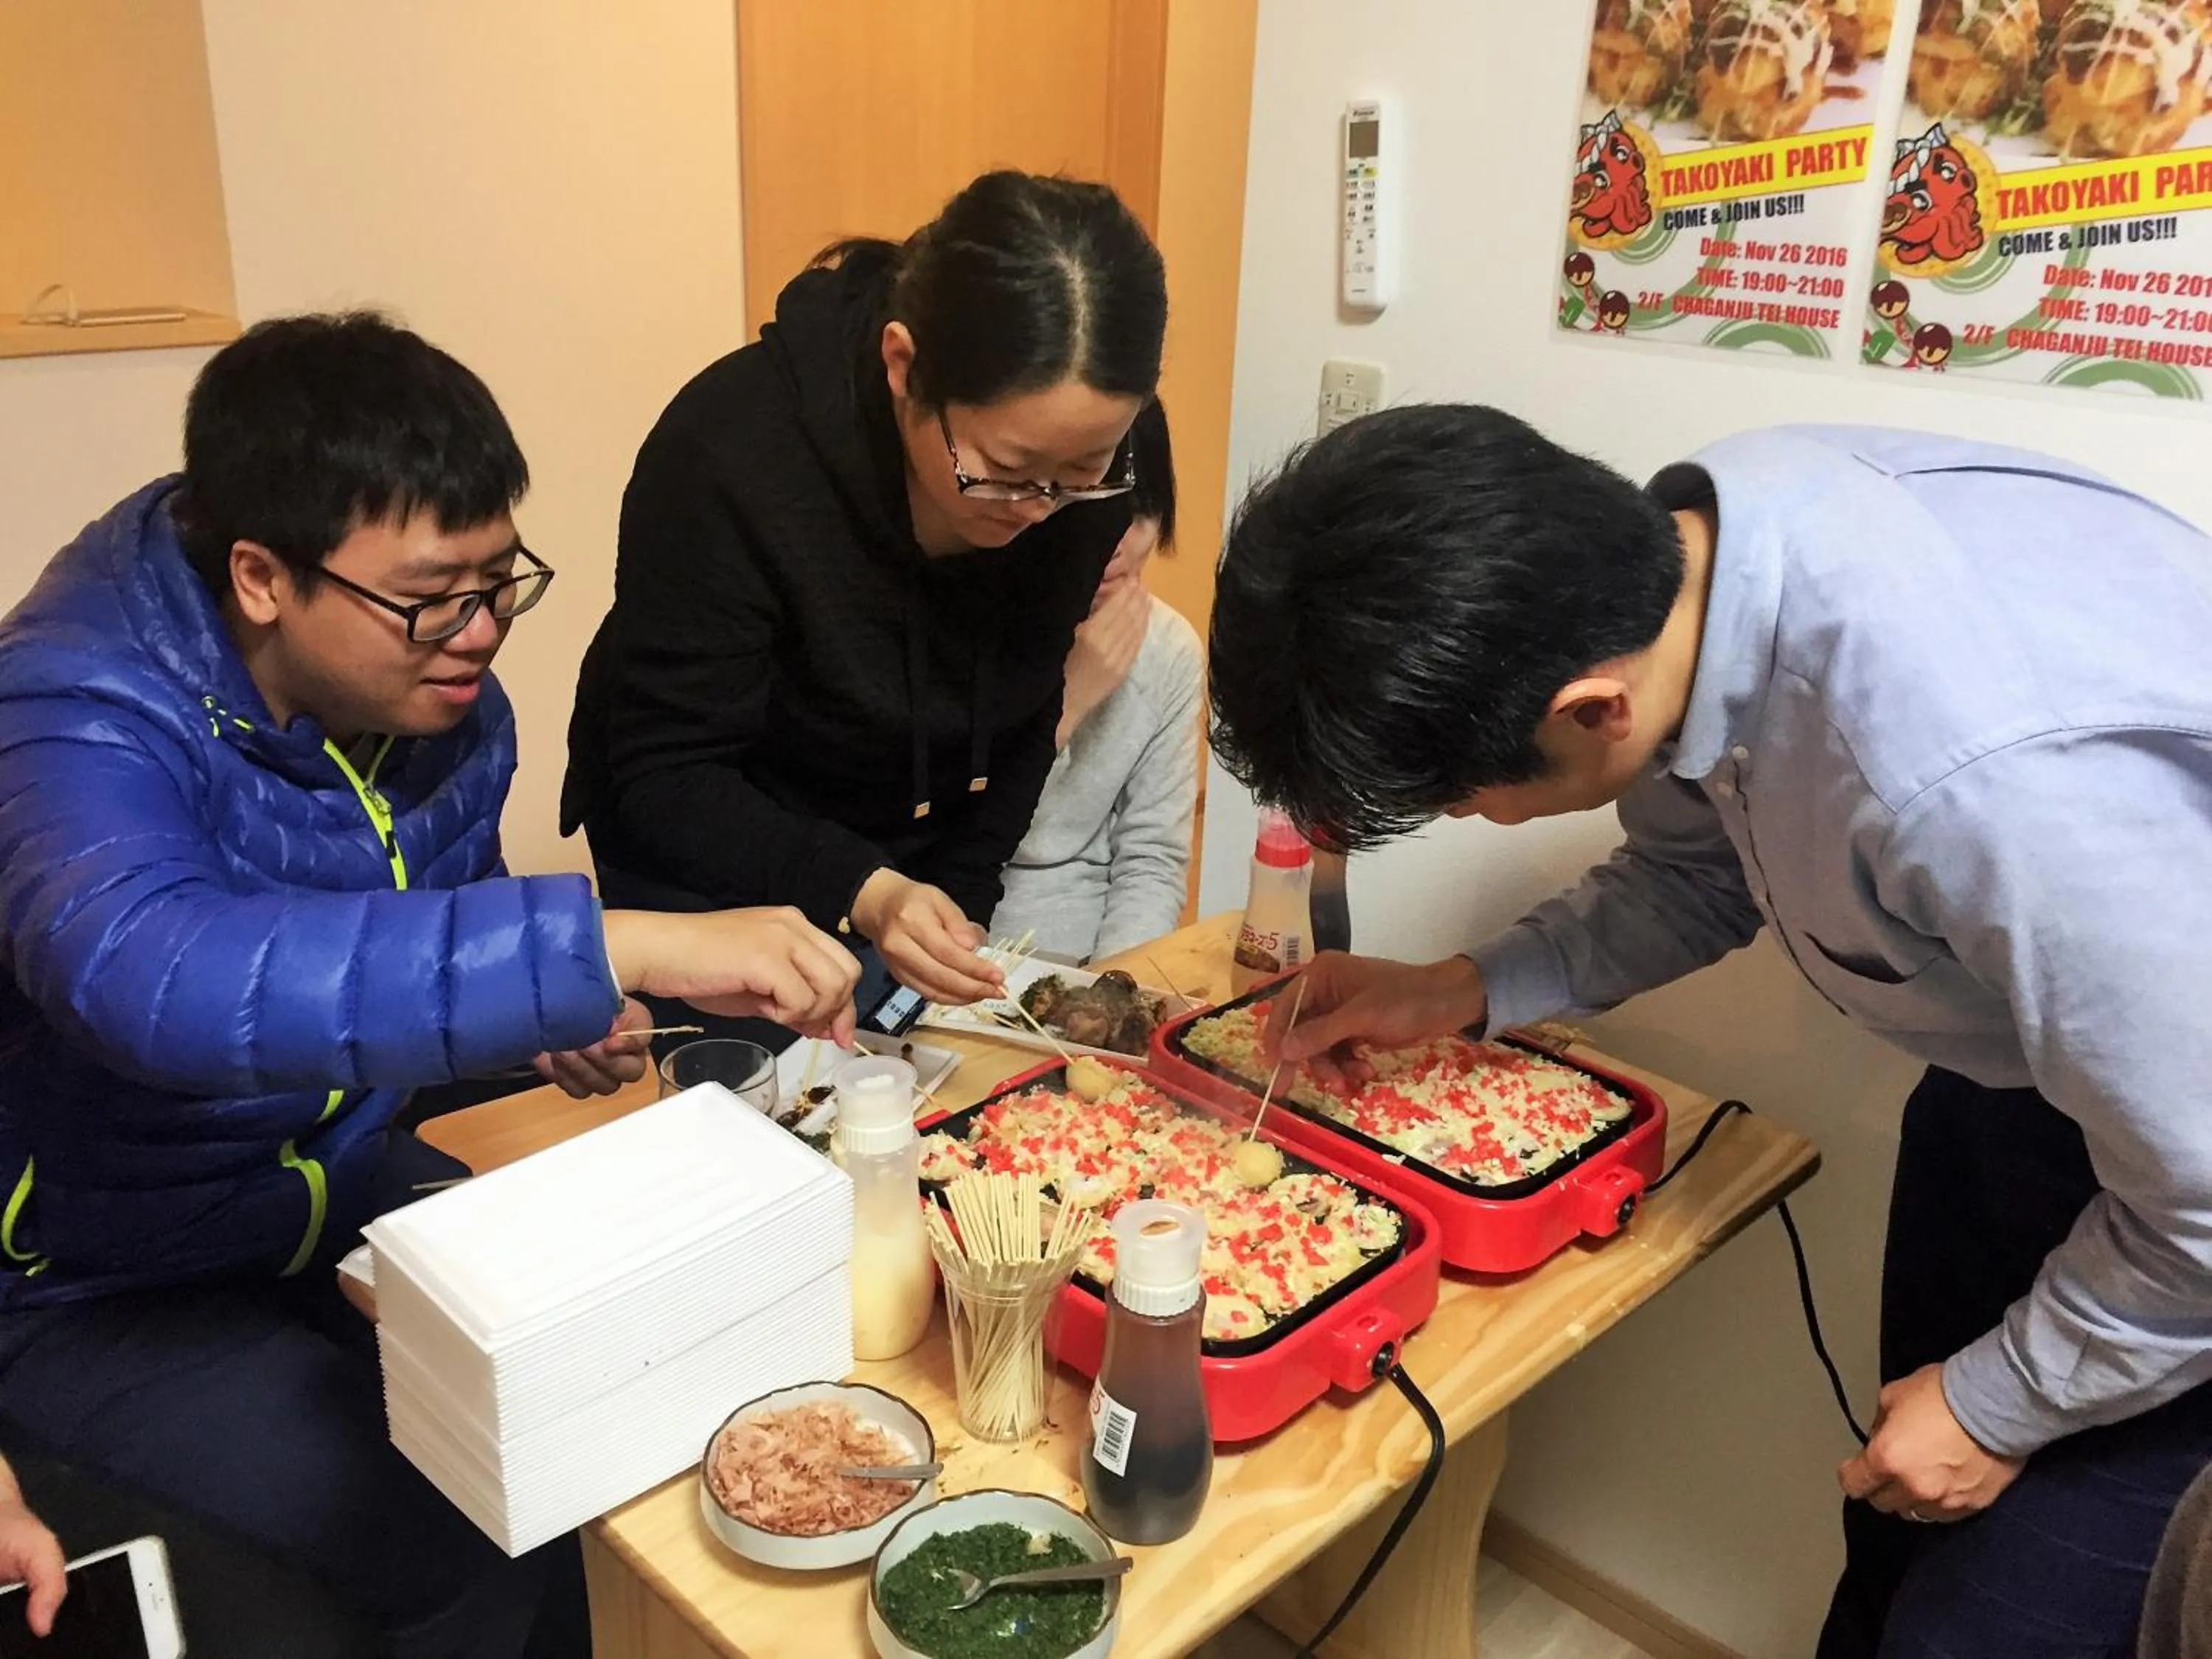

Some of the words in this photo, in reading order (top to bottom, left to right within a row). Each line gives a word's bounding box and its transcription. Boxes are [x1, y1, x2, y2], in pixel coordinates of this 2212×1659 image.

[1660, 153, 1773, 196] TAKOYAKI
[1786, 137, 1867, 178] PARTY
[1995, 170, 2140, 220] TAKOYAKI
[2155, 160, 2212, 199] PAR
[1663, 207, 1707, 230] COME
[1711, 209, 1722, 225] &
[1726, 201, 1760, 223] JOIN
[1765, 194, 1804, 217] US!!!
[1700, 237, 1741, 258] Date:
[1745, 241, 1776, 260] Nov
[1778, 243, 1801, 263] 26
[1804, 246, 1848, 267] 2016
[1998, 232, 2053, 257] COME
[2058, 232, 2072, 251] &
[2077, 223, 2121, 248] JOIN
[2127, 217, 2177, 243] US!!!
[1697, 267, 1738, 288] TIME:
[1742, 271, 1844, 299] 19:00~21:00
[2043, 264, 2096, 288] Date:
[2099, 269, 2139, 291] Nov
[2142, 271, 2171, 294] 26
[2174, 274, 2212, 297] 201
[1638, 291, 1663, 310] 2/F
[1672, 295, 1753, 319] CHAGANJU
[1757, 302, 1781, 322] TEI
[1784, 306, 1841, 329] HOUSE
[2038, 296, 2090, 321] TIME:
[1962, 324, 1994, 347] 2/F
[2006, 328, 2107, 357] CHAGANJU
[2113, 338, 2142, 360] TEI
[2147, 340, 2212, 367] HOUSE
